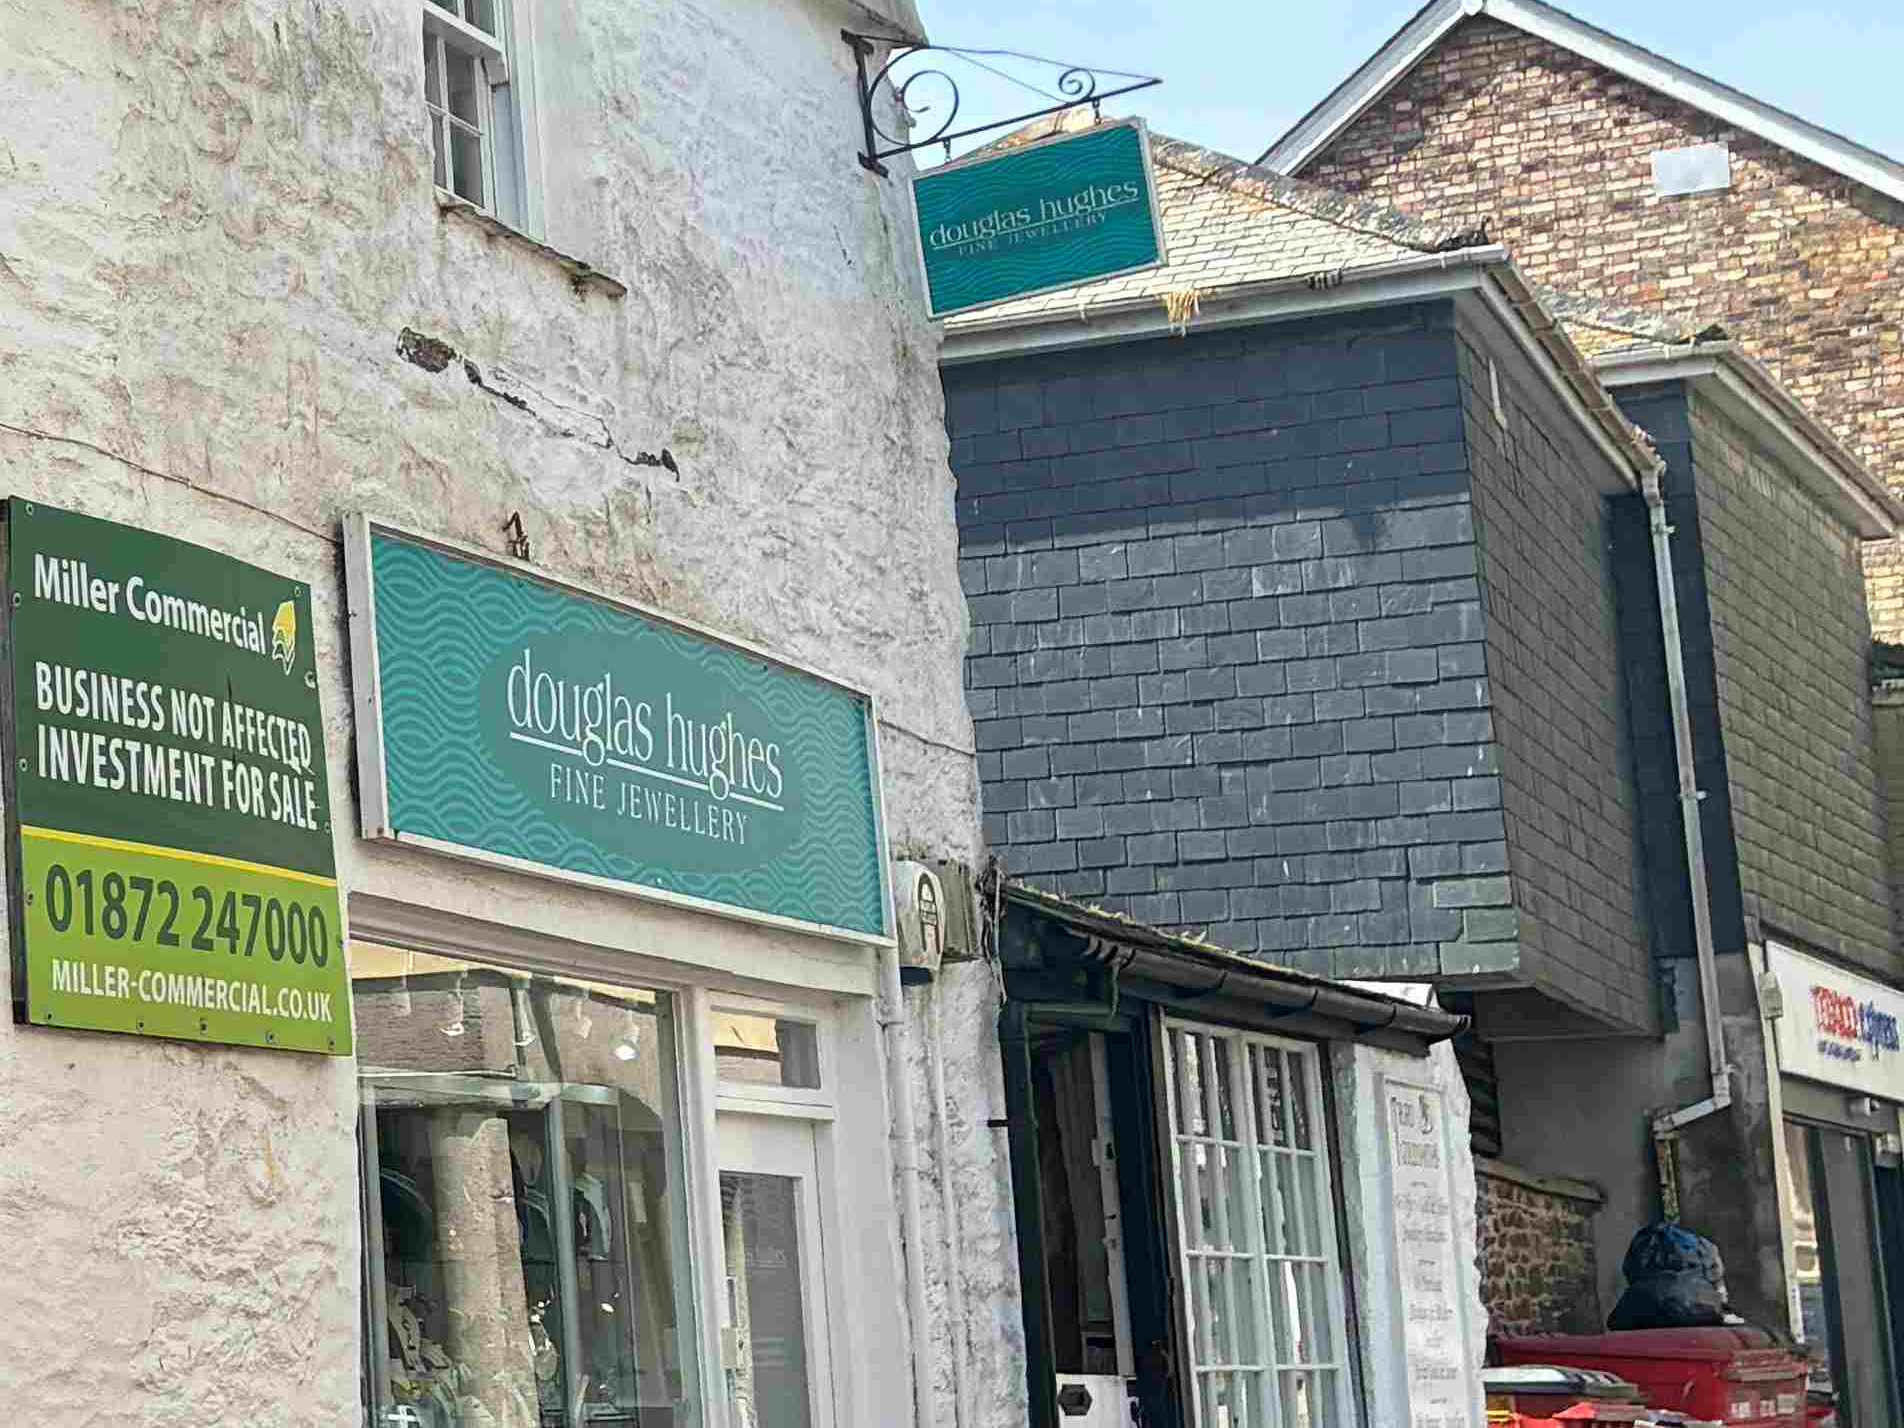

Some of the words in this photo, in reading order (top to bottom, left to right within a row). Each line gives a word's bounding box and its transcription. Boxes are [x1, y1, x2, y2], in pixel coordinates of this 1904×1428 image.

[930, 208, 1031, 248] douglas
[1039, 181, 1139, 221] hughes
[33, 553, 120, 615] Miller
[126, 576, 267, 655] Commercial
[34, 660, 166, 734] BUSINESS
[171, 688, 216, 743] NOT
[221, 701, 311, 773] AFFECTED
[507, 649, 653, 766] douglas
[666, 692, 784, 801] hughes
[37, 724, 215, 808] INVESTMENT
[222, 762, 267, 819] FOR
[270, 771, 319, 830] SALE
[550, 764, 606, 810] FINE
[617, 782, 748, 846] JEWELLERY
[45, 863, 181, 948] 01872
[191, 884, 329, 969] 247000
[51, 958, 333, 1023] MILLER-COMMERCIAL.CO.UK
